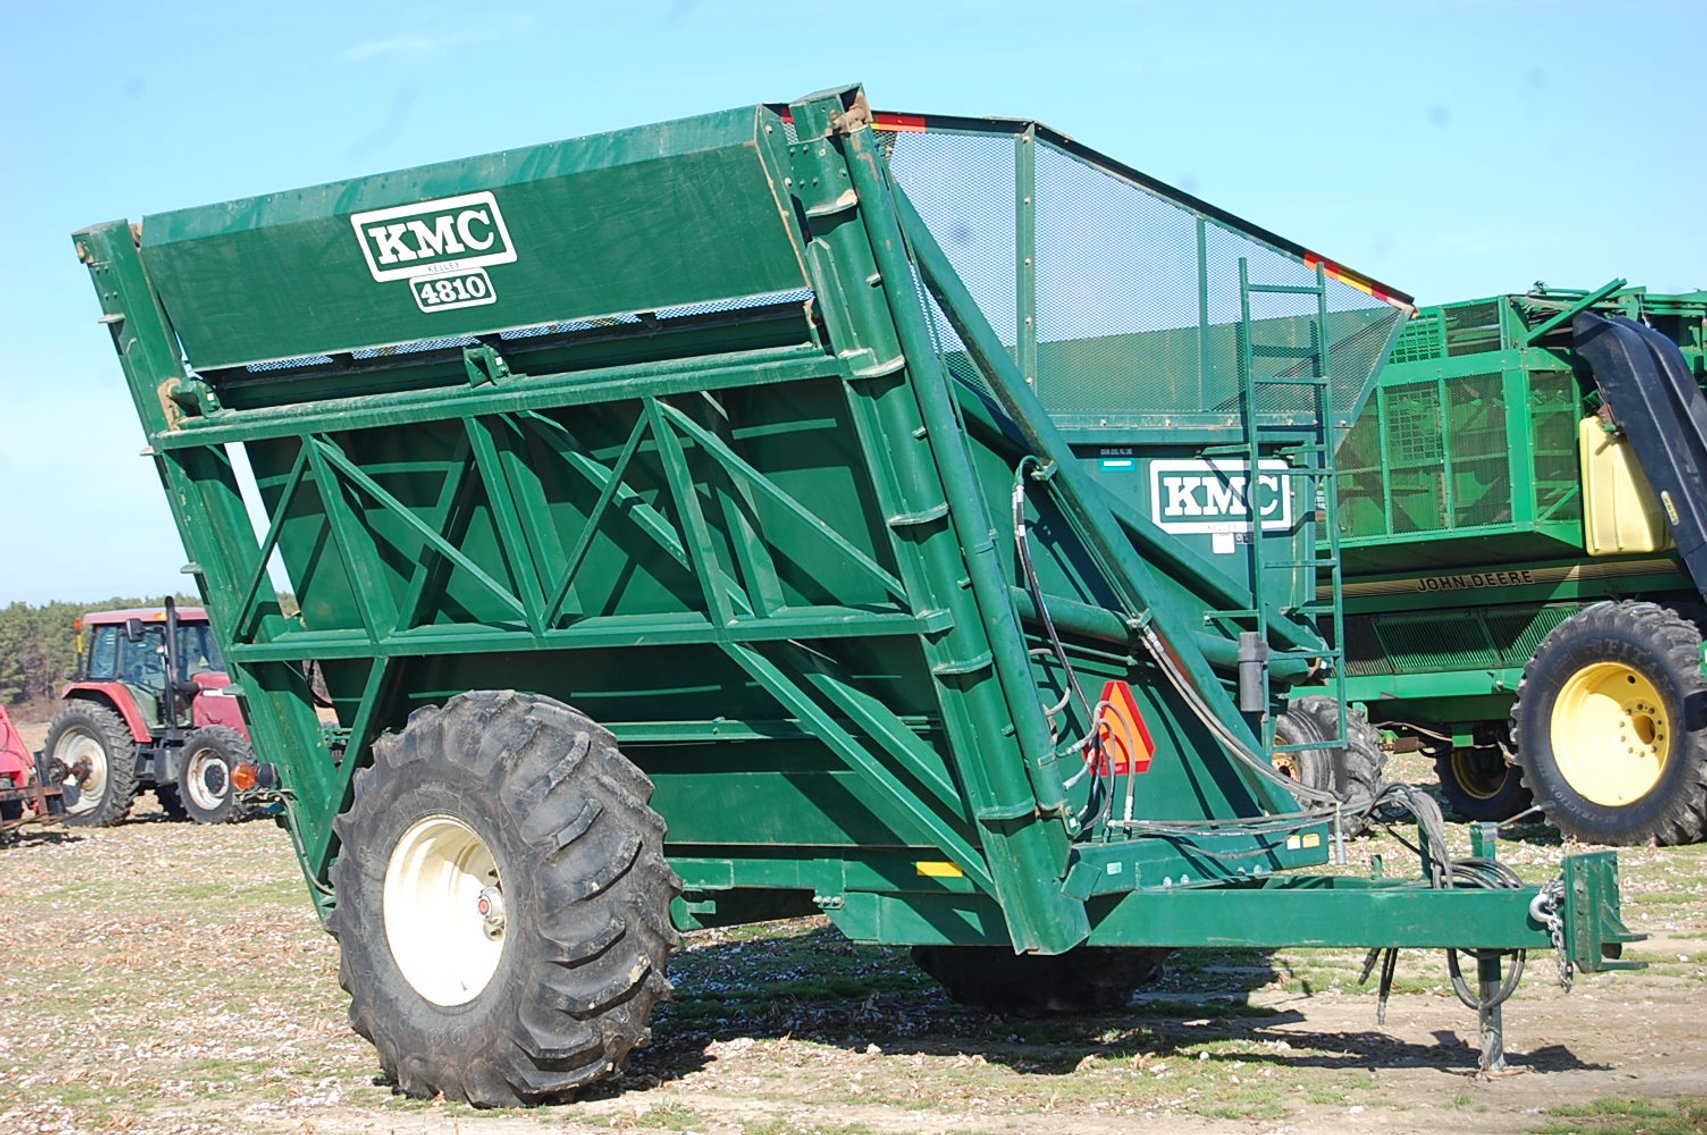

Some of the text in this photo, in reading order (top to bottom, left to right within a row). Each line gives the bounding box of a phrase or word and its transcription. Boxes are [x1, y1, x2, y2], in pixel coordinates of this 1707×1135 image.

[368, 209, 494, 265] KMC
[427, 262, 460, 273] KELLEY
[420, 276, 486, 304] 4810
[1163, 475, 1278, 516] KMC
[1417, 571, 1533, 592] JOHN DEERE
